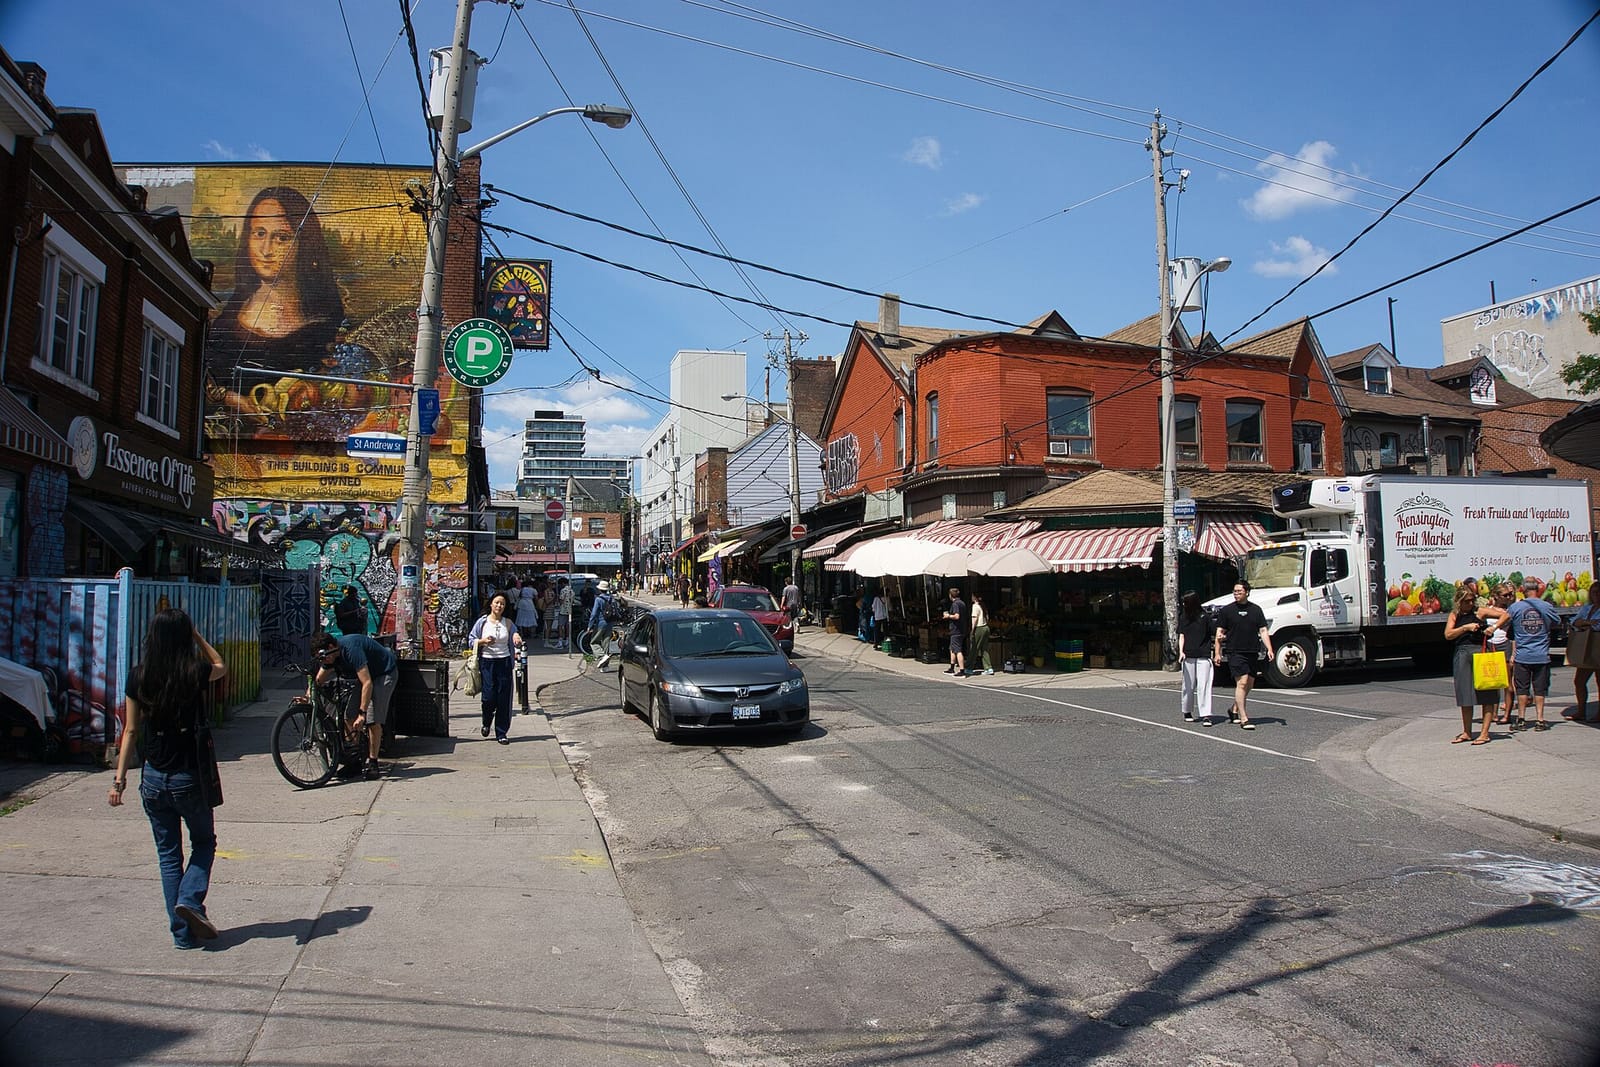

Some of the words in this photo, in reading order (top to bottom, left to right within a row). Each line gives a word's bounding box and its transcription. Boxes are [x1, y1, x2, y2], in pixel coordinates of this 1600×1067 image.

[491, 267, 542, 293] WELCOME
[448, 322, 510, 352] MUNICIPAL
[466, 336, 494, 362] P
[447, 357, 509, 385] PARKING
[354, 439, 362, 449] St
[363, 439, 393, 450] Andrew
[103, 431, 159, 483] Essence
[161, 456, 177, 489] Of
[177, 462, 196, 509] Life
[267, 461, 289, 471] THIS
[293, 462, 338, 473] BUILDING
[340, 463, 350, 473] IS
[320, 477, 361, 487] OWNED
[1396, 511, 1450, 530] Kensington
[1463, 506, 1486, 519] Fresh
[1487, 506, 1511, 519] Fruits
[1512, 507, 1528, 519] and
[1529, 507, 1570, 522] Vegetables
[1395, 531, 1418, 546] Fruit
[1421, 530, 1454, 546] Market
[1514, 531, 1528, 544] For
[1530, 531, 1549, 543] Over
[1550, 525, 1565, 543] 40
[1470, 557, 1479, 567] 36
[1488, 556, 1513, 566] Andrew
[1553, 555, 1563, 564] ON
